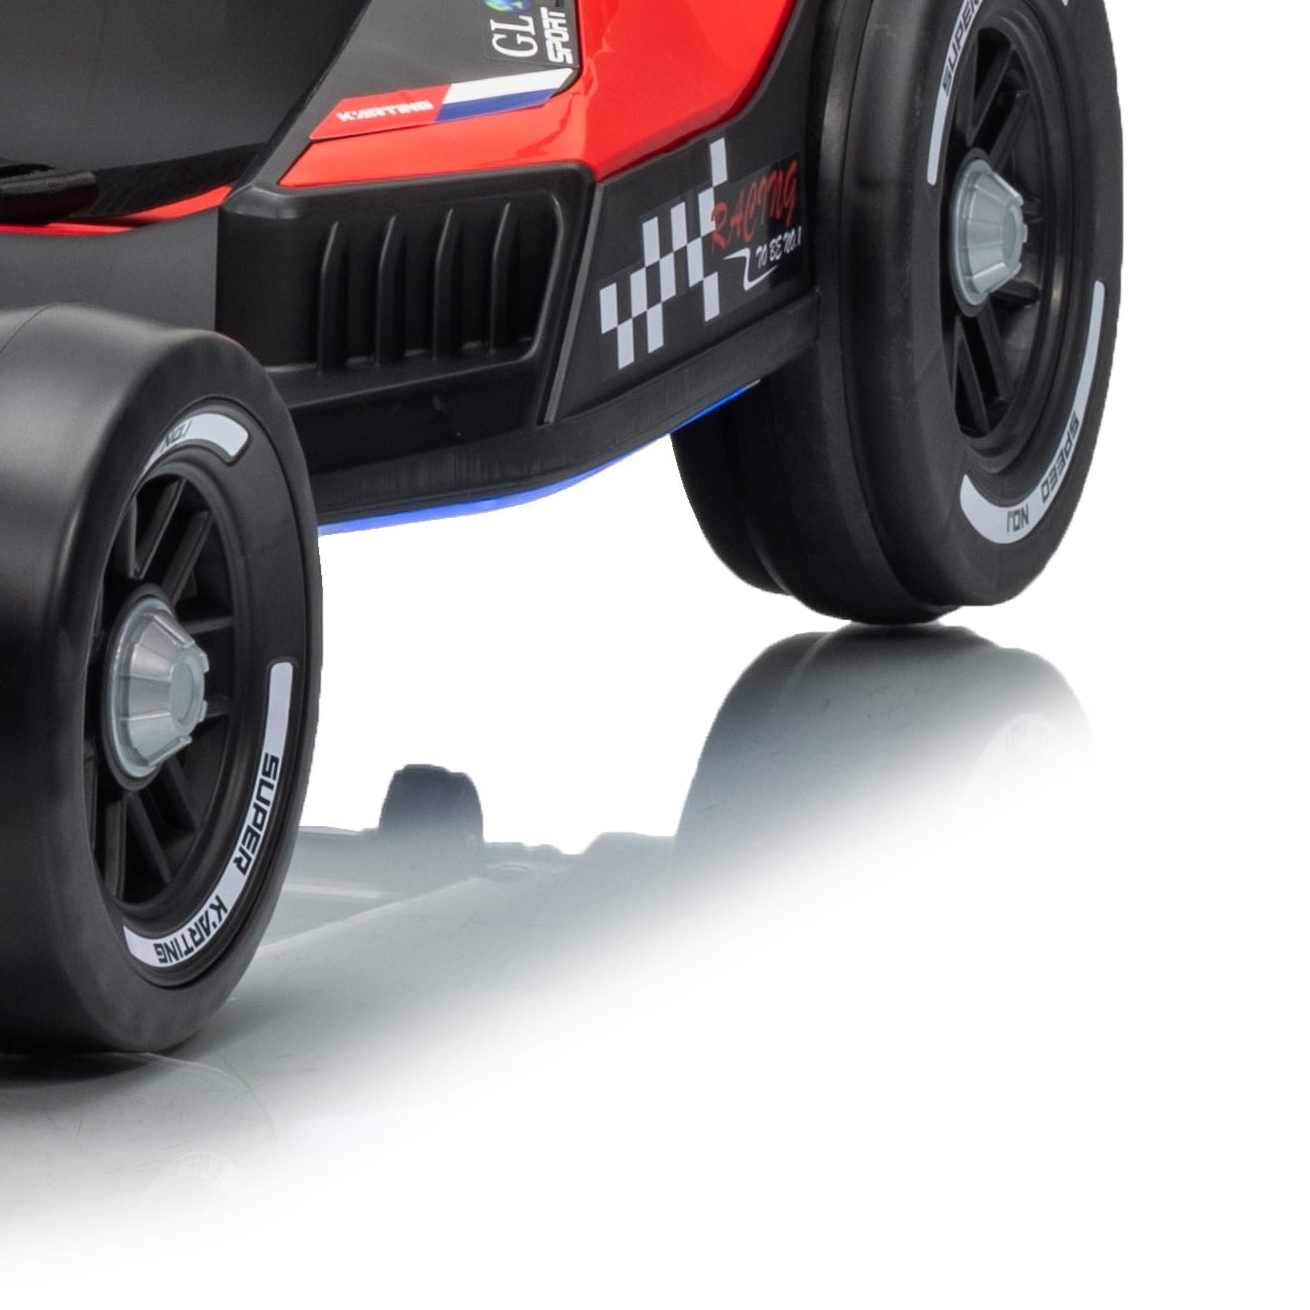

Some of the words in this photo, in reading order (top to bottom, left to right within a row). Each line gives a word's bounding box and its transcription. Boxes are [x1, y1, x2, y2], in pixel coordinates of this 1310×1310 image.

[539, 6, 574, 65] SPORT
[710, 159, 798, 254] RACING
[1041, 410, 1080, 504] SPEED
[232, 752, 280, 876] SUPER
